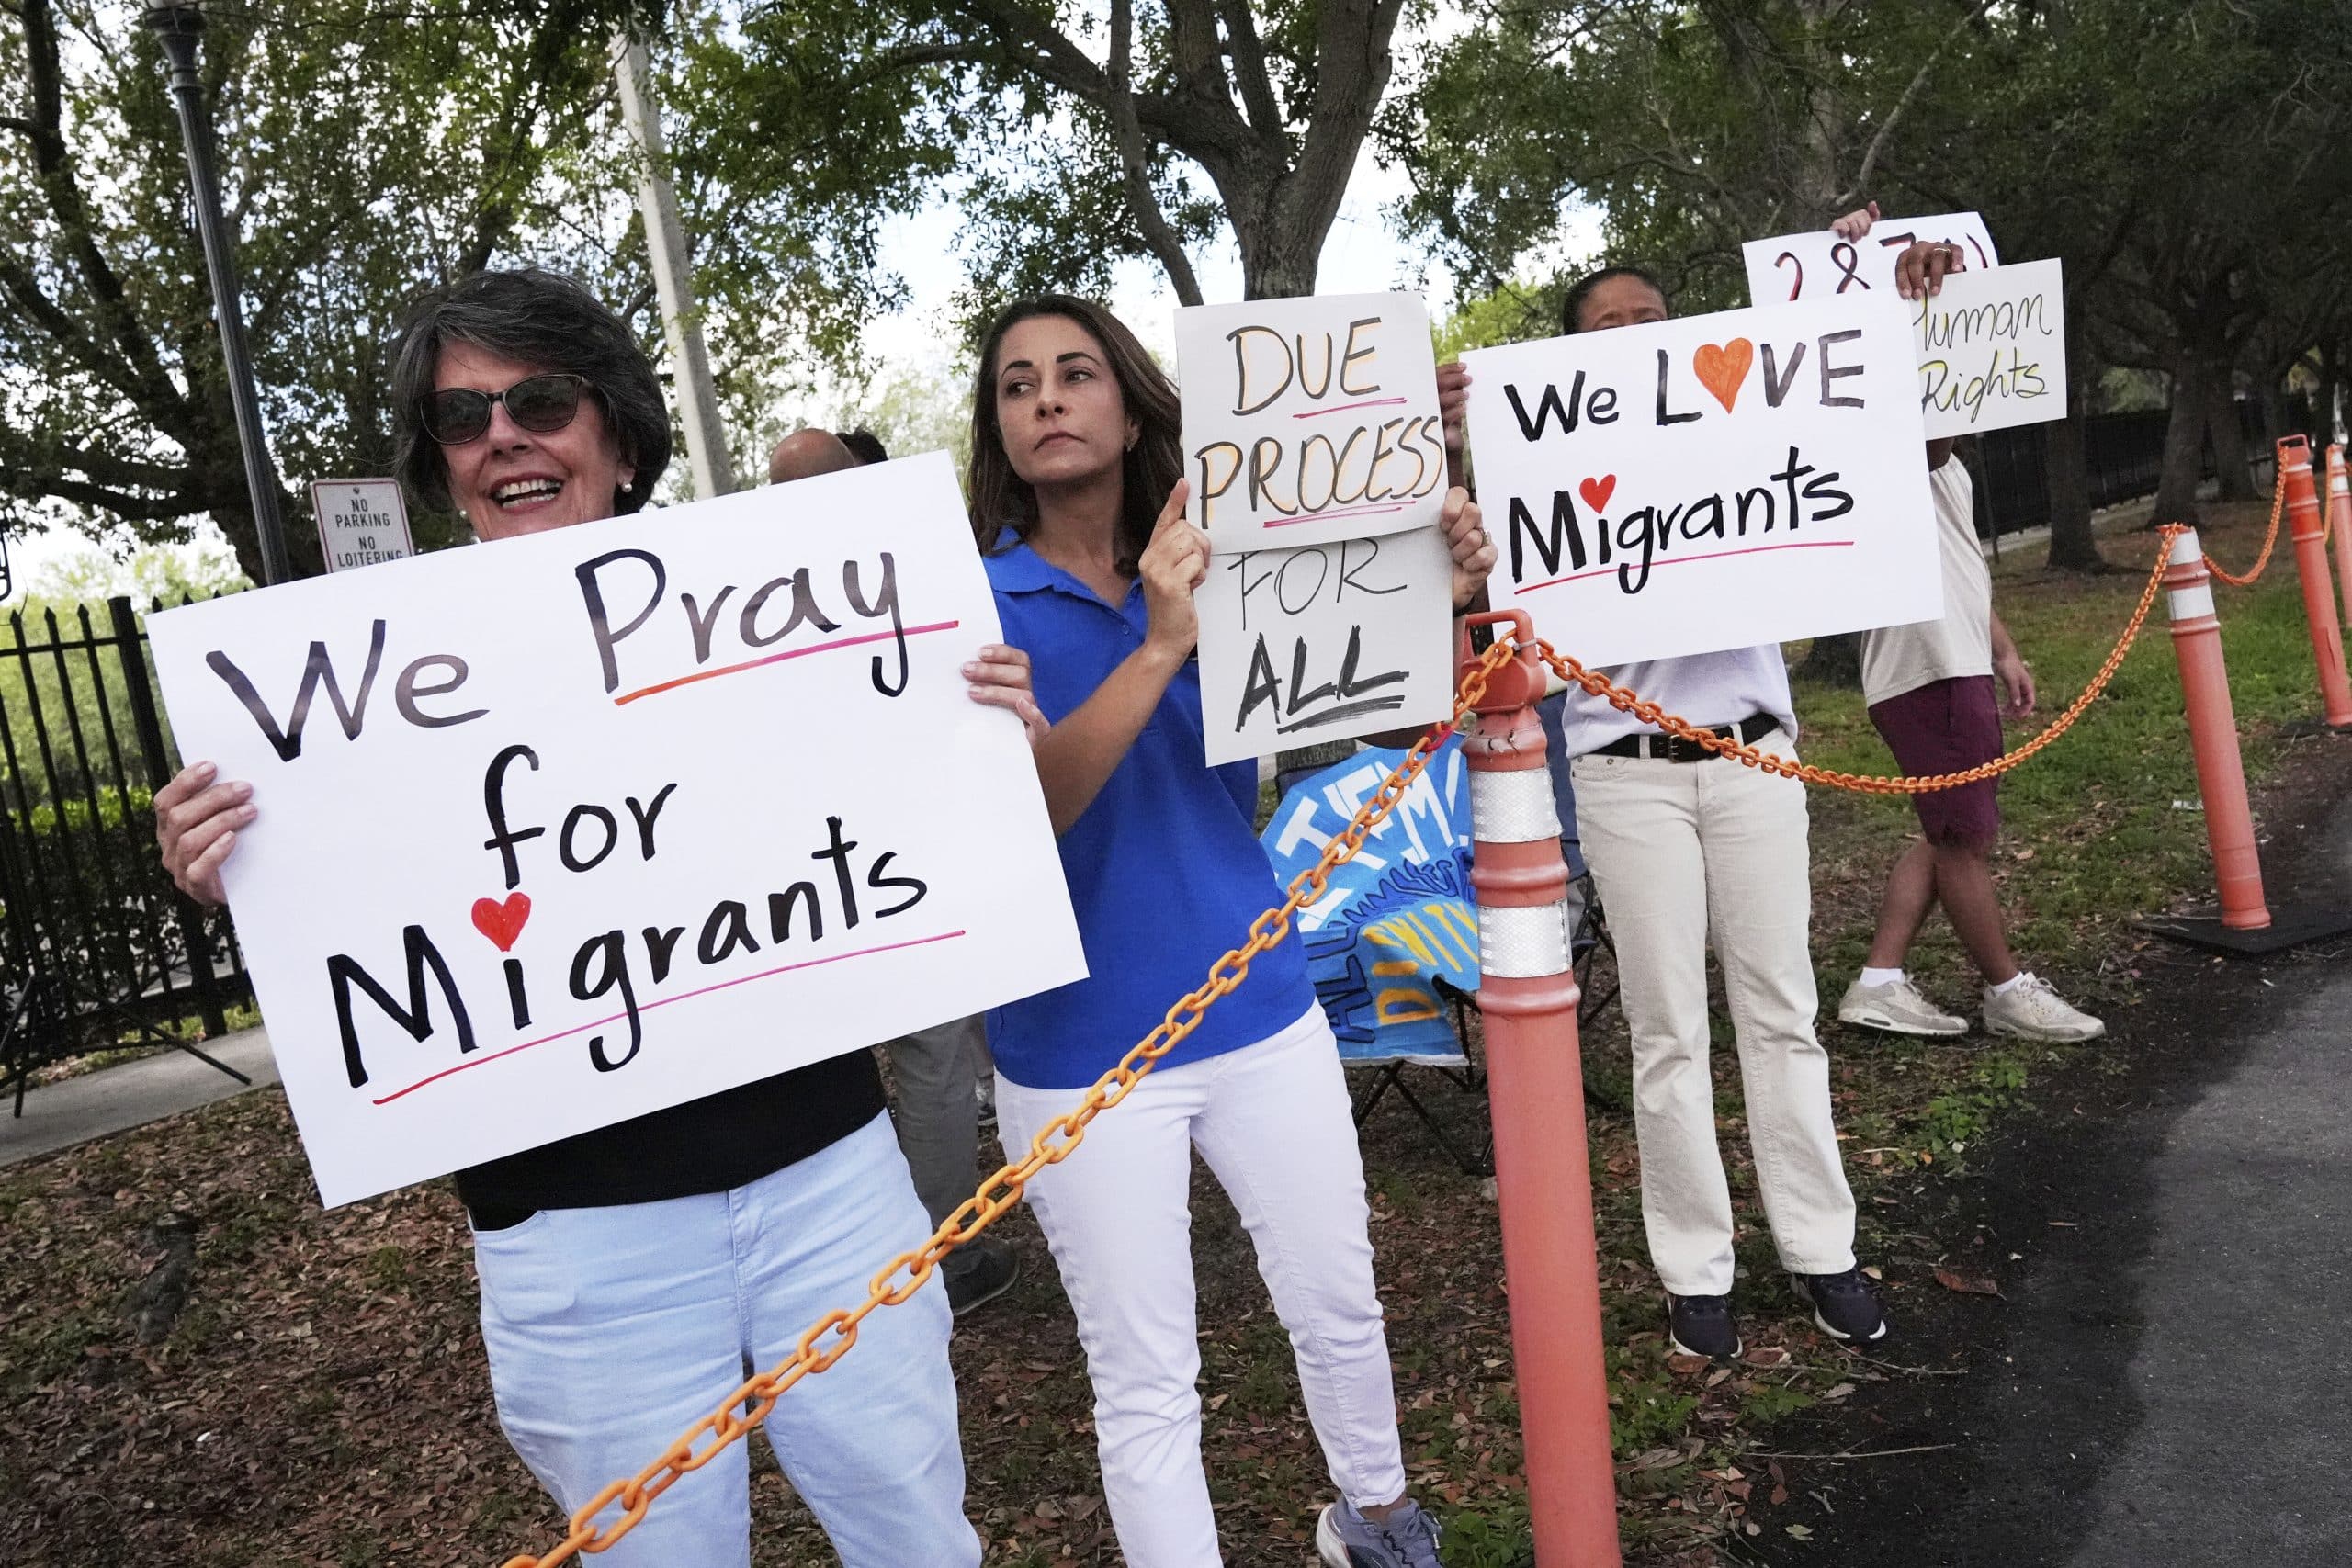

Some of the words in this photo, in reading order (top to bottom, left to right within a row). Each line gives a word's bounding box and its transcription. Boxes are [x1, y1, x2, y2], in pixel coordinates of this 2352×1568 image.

[1226, 316, 1383, 416] DUE
[1503, 369, 1621, 443] We
[1918, 347, 2049, 423] Rights
[334, 513, 390, 528] PARKING
[351, 498, 368, 512] NO
[1194, 415, 1444, 530] PROCESS
[1509, 446, 1855, 595] Migrants
[358, 536, 376, 550] NO
[1227, 537, 1408, 631] FOR
[205, 619, 491, 763] We
[574, 548, 909, 698] Pray
[1235, 624, 1411, 734] ALL
[483, 744, 678, 891] for
[325, 815, 928, 1088] Migrants
